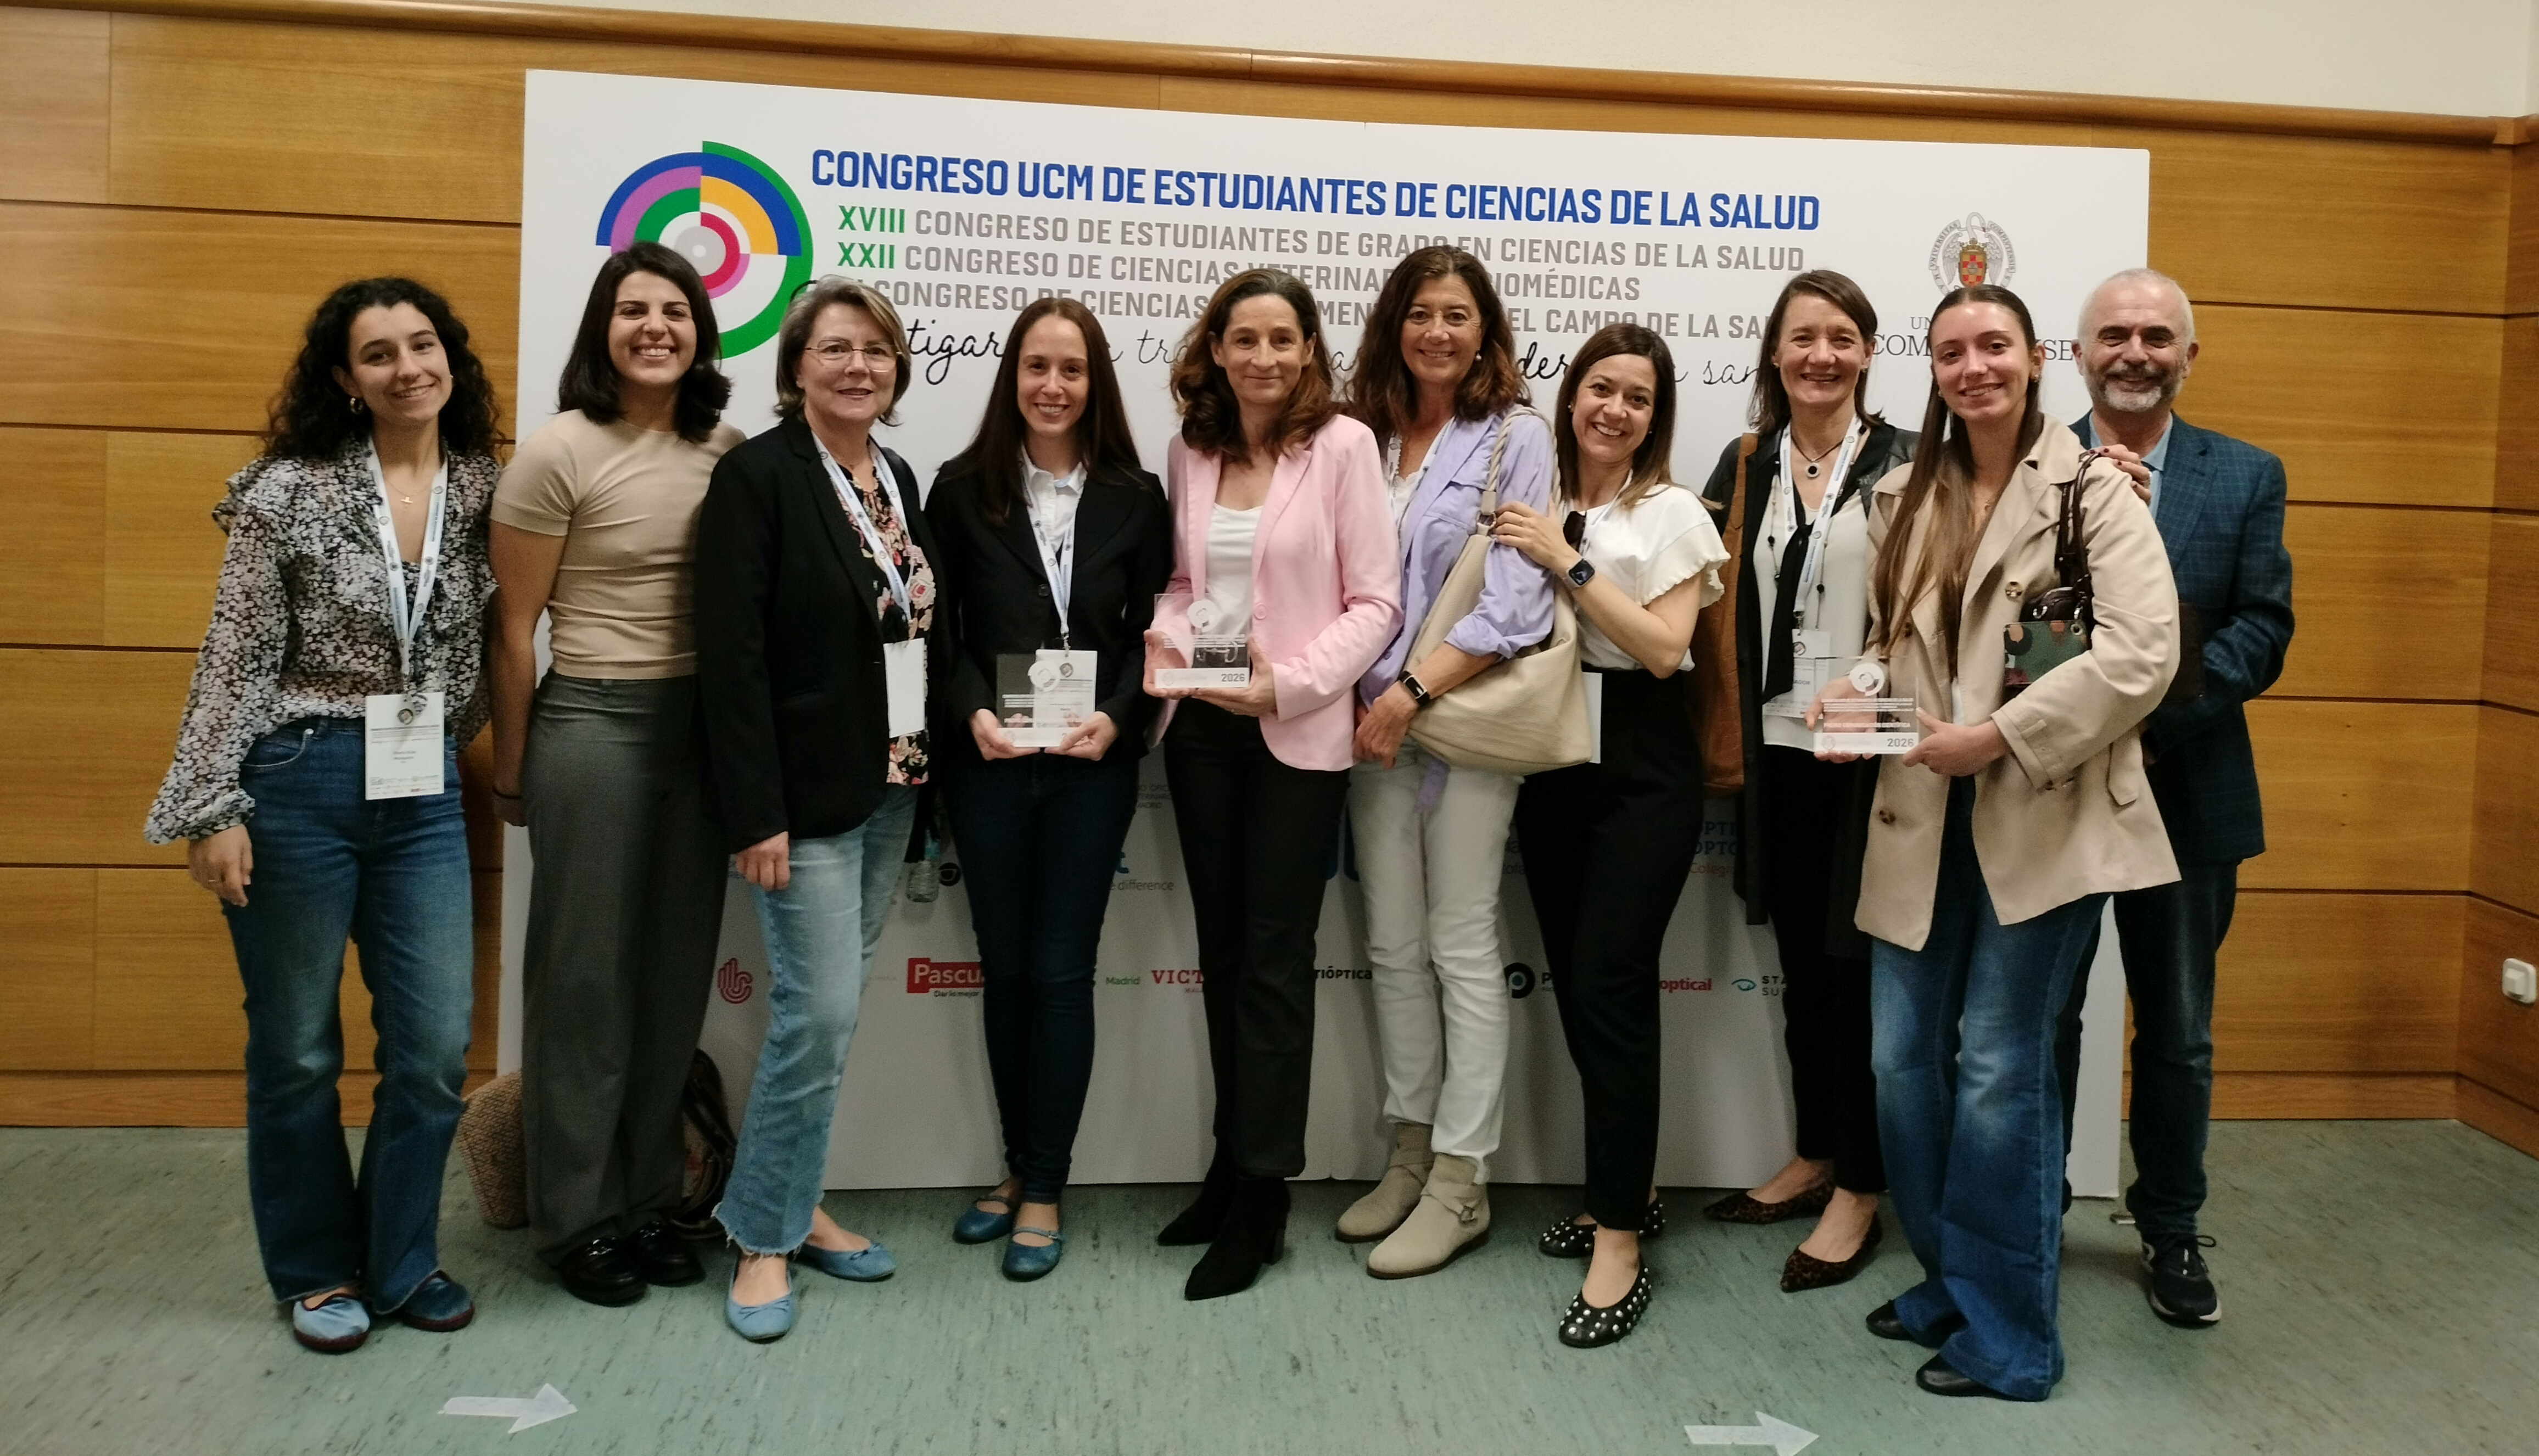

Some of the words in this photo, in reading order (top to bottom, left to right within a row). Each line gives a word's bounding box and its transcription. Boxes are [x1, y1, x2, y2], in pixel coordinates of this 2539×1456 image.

[813, 149, 1009, 196] CONGRESO
[1019, 163, 1093, 200] UCM
[1103, 167, 1145, 204] DE
[1155, 170, 1386, 216] ESTUDIANTES
[1396, 182, 1438, 218] DE
[1446, 183, 1602, 223] CIENCIAS
[1610, 190, 1652, 226] DE
[1661, 192, 1701, 227] LA
[1710, 193, 1820, 231] SALUD
[838, 205, 905, 233] XVIII
[915, 210, 1068, 242] CONGRESO
[1078, 219, 1112, 244] DE
[1121, 221, 1307, 254] ESTUDIANTES
[1316, 231, 1350, 256] DE
[1501, 238, 1626, 267] CIENCIAS
[1635, 243, 1668, 268] DE
[1676, 244, 1708, 269] LA
[1716, 245, 1804, 271] SALUD
[838, 242, 895, 269] XXII
[905, 245, 1058, 277] CONGRESO
[1068, 254, 1102, 279] DE
[1111, 256, 1239, 286] CIENCIAS
[1495, 268, 1640, 301] IOMÉDICAS
[1080, 290, 1212, 319] CIENCIAS
[1508, 307, 1537, 332] EL
[1648, 312, 1679, 337] DE
[1687, 313, 1719, 338] LA
[1221, 673, 1245, 682] 2026
[1887, 738, 1914, 747] 2026
[914, 964, 985, 984] Pascu
